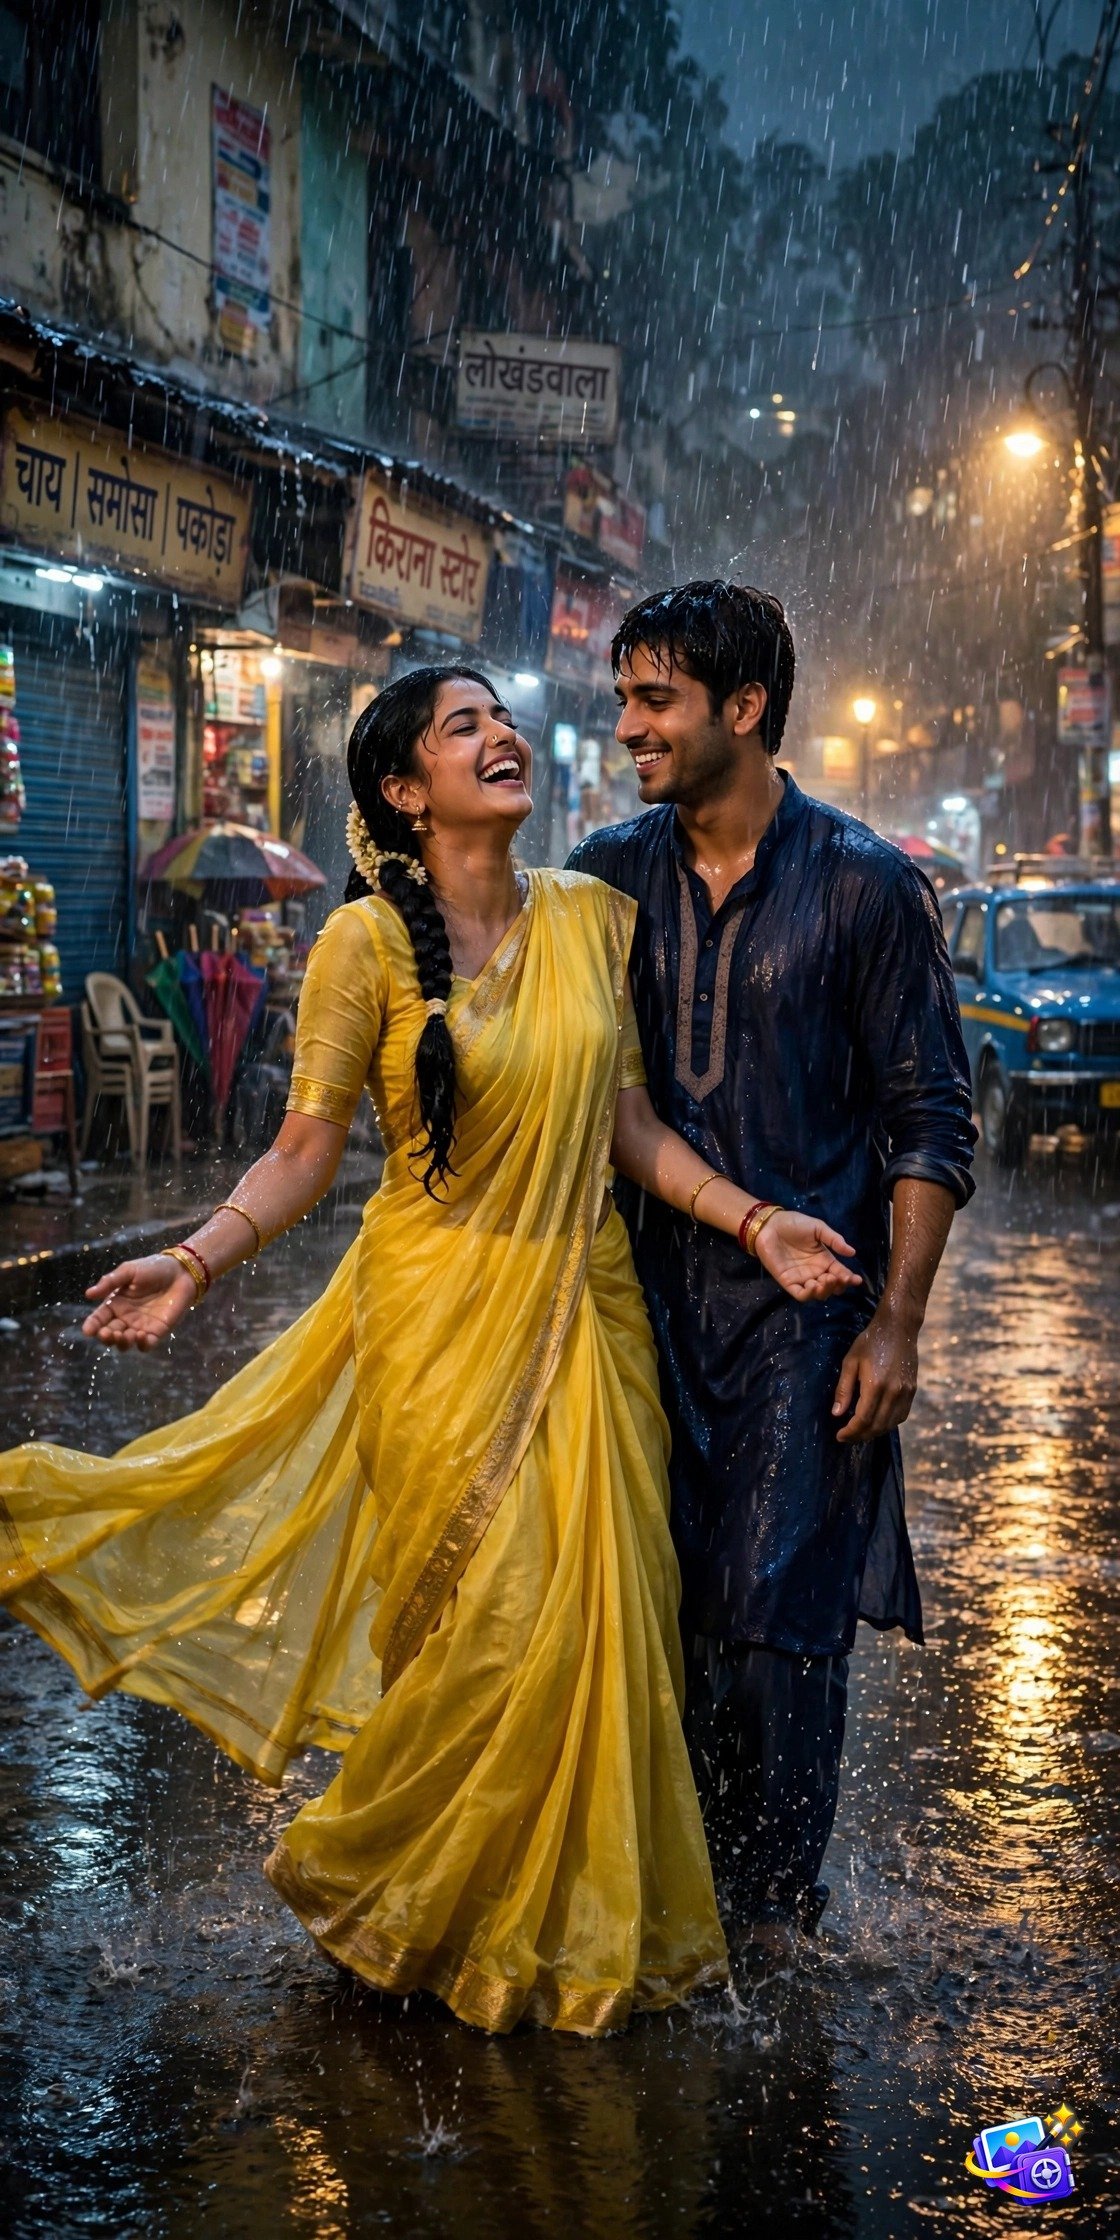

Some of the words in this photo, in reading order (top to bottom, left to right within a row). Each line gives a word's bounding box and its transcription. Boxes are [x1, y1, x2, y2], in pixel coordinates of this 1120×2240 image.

[464, 340, 610, 400] लोखंडवाला
[16, 441, 67, 513] चाय
[87, 455, 159, 542] समोसा
[177, 485, 237, 577] पकोड़ा
[367, 496, 437, 590] किराना
[440, 533, 481, 606] स्टोर
